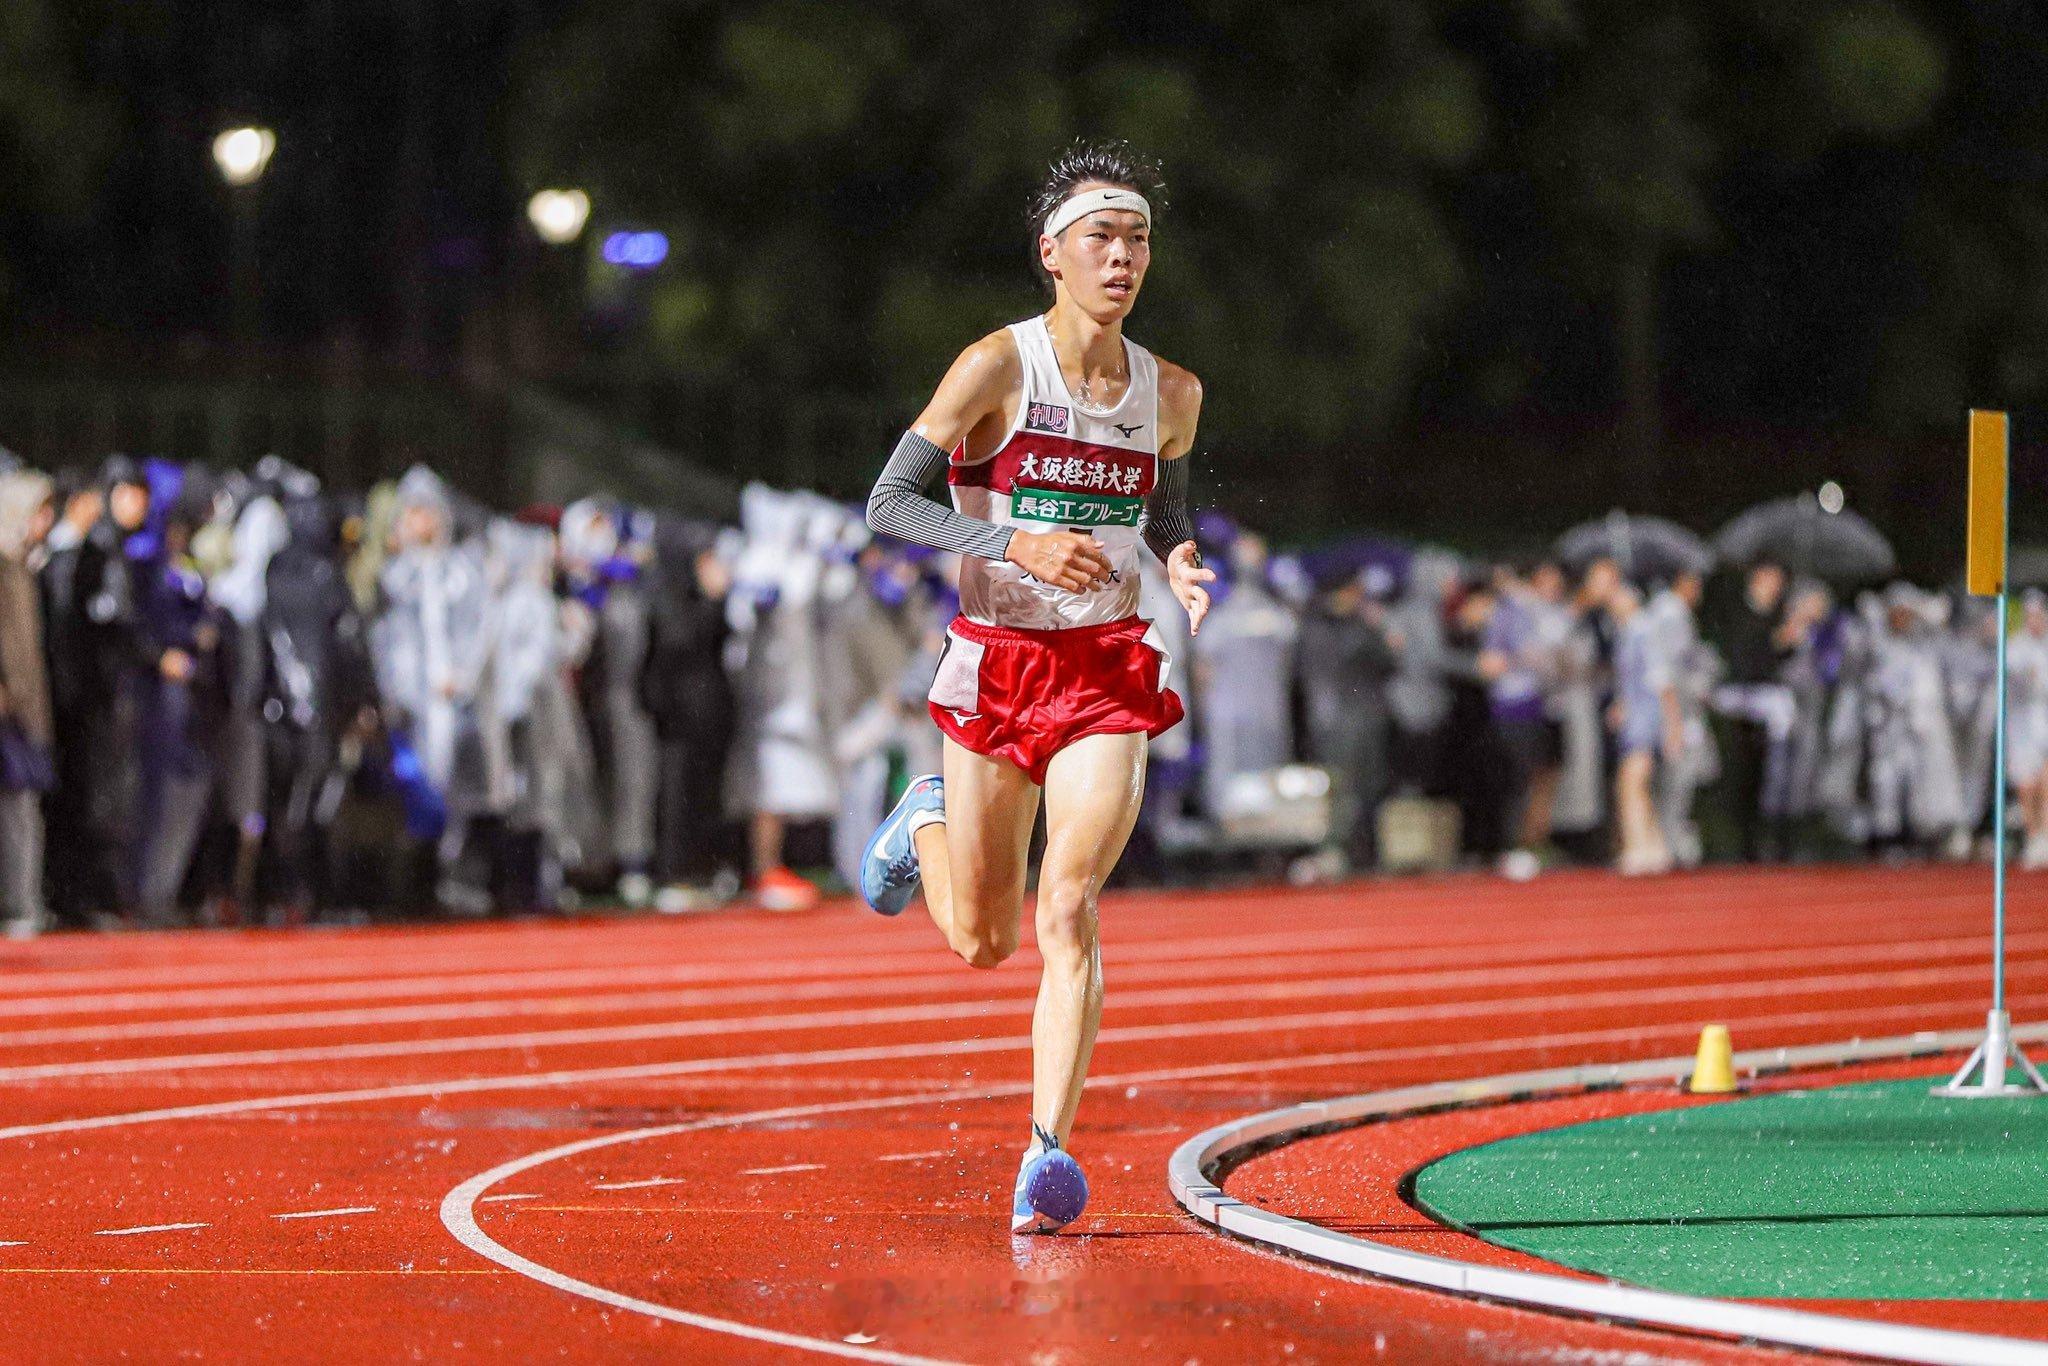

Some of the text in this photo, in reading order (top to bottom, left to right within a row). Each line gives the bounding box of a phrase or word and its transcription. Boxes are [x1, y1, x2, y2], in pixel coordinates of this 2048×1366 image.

[1028, 404, 1068, 432] HUB
[1018, 452, 1142, 494] 大阪経済大学
[1017, 496, 1140, 522] 長谷工グループ
